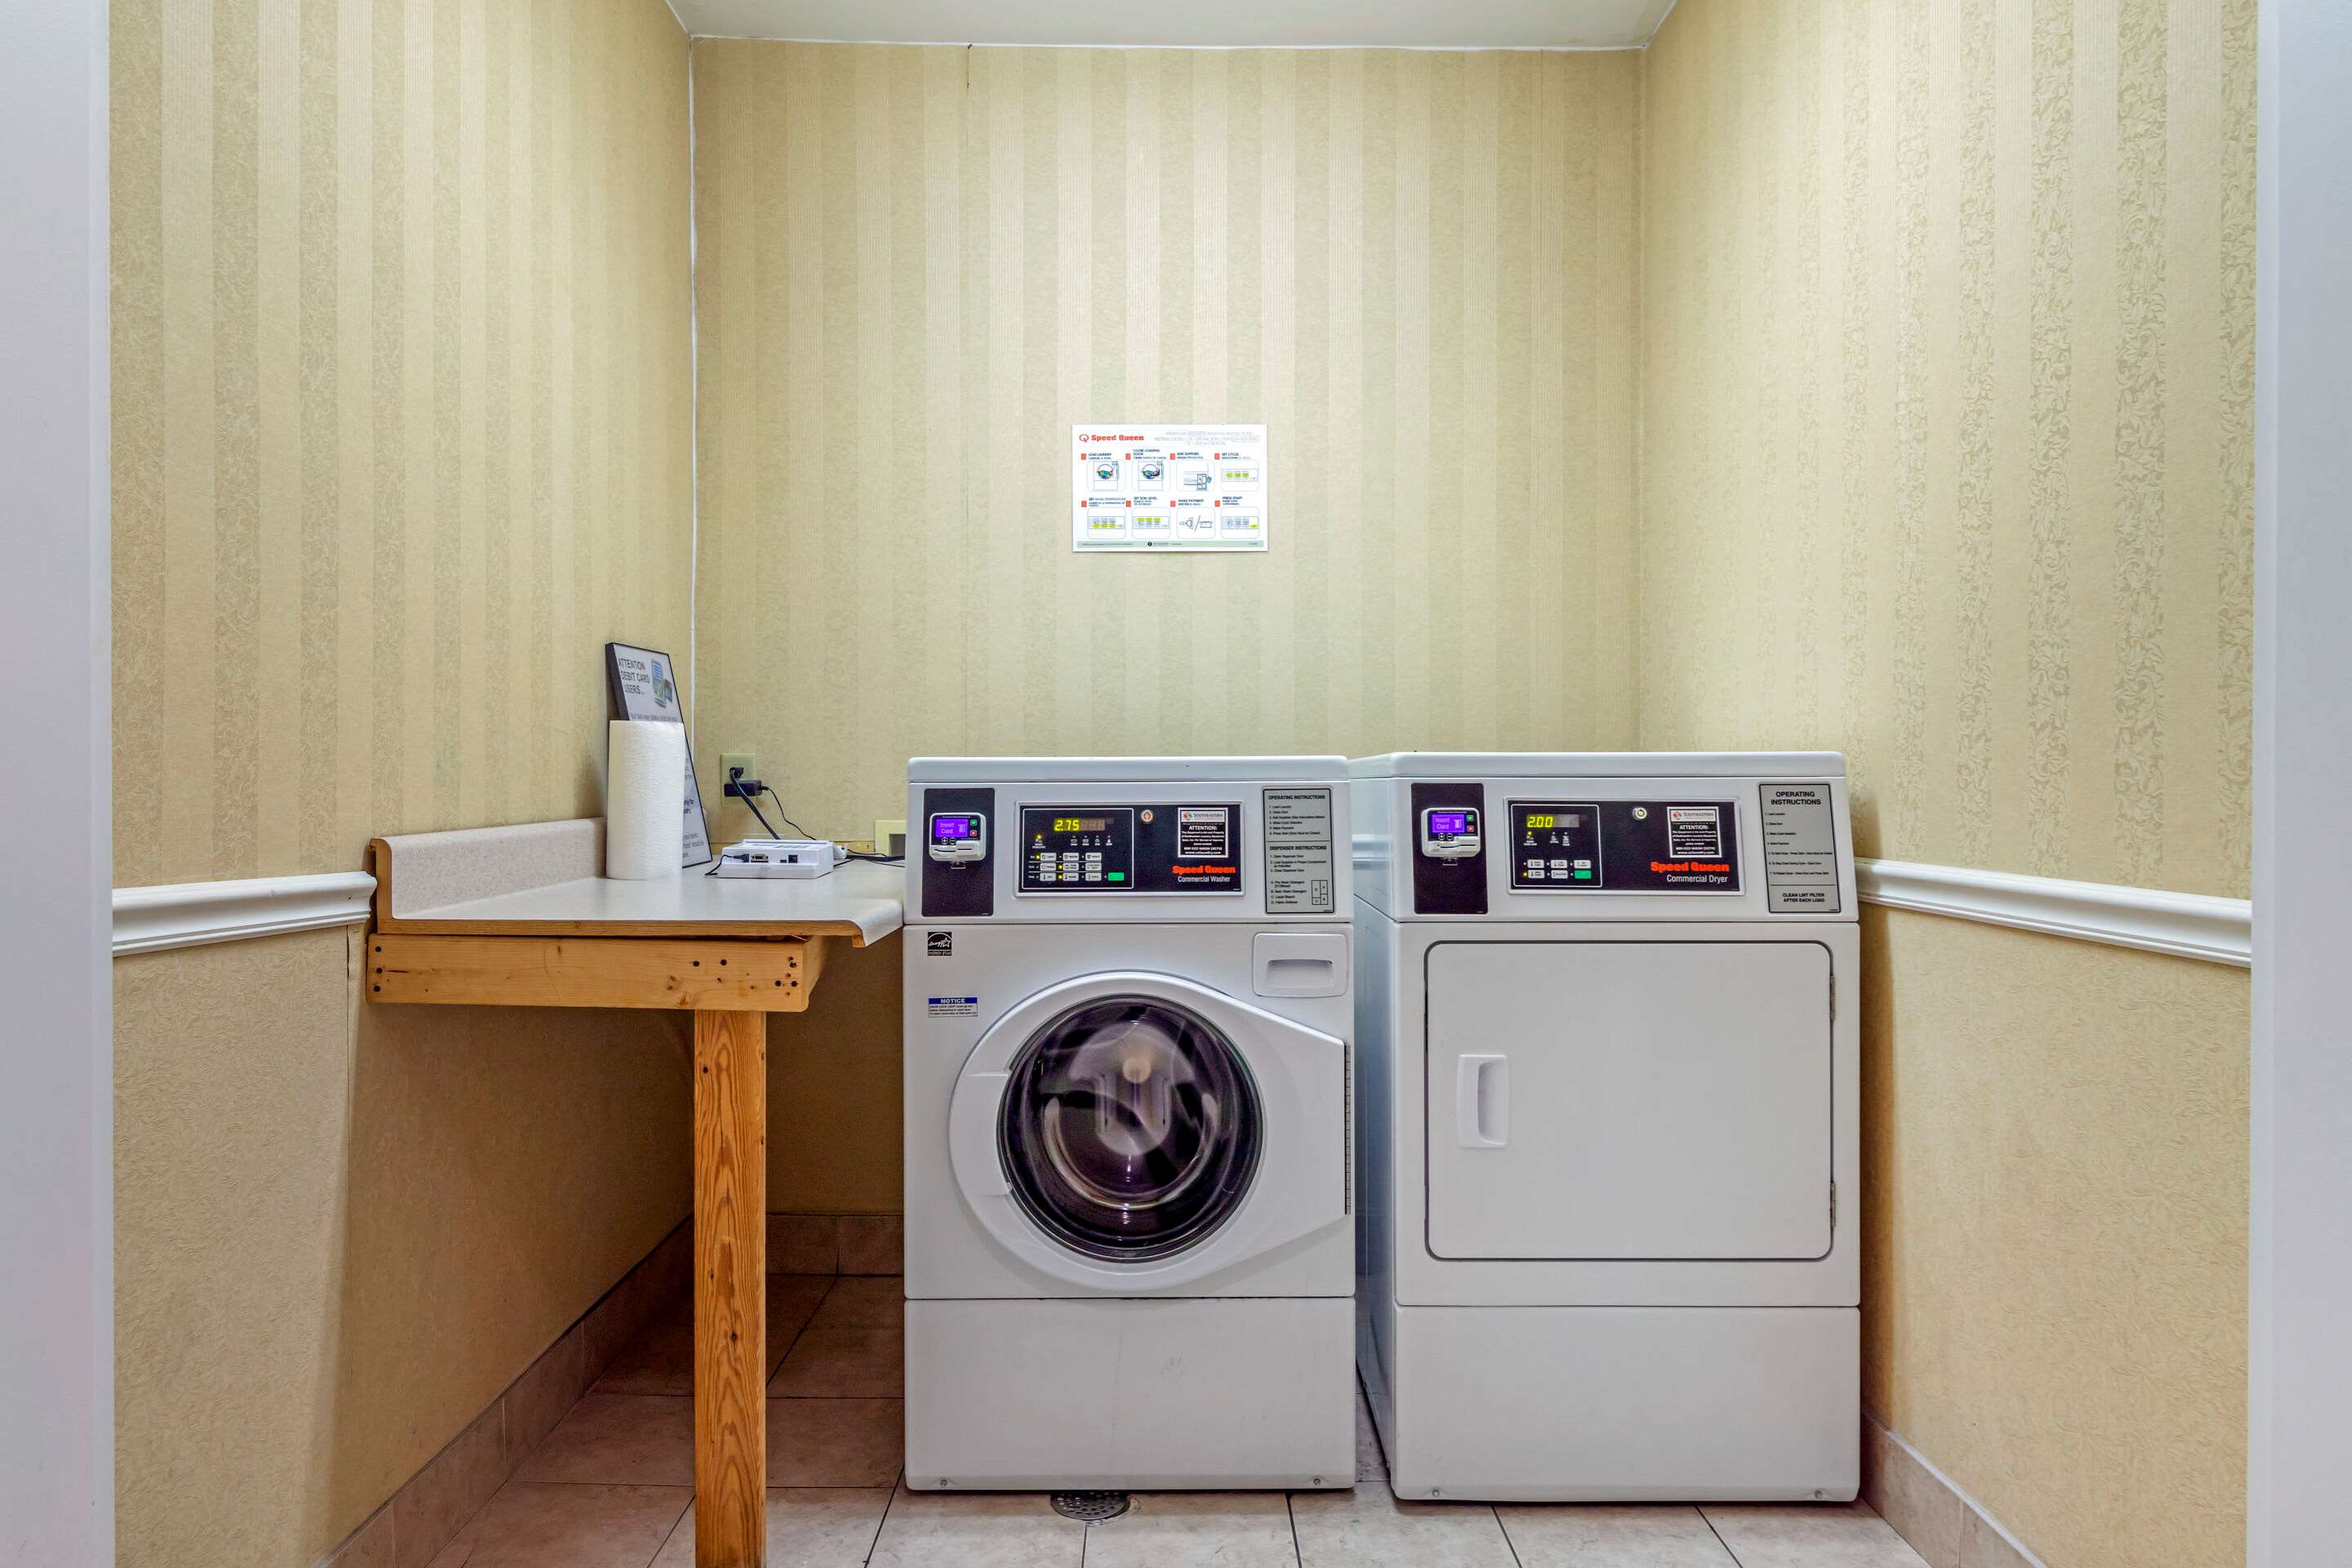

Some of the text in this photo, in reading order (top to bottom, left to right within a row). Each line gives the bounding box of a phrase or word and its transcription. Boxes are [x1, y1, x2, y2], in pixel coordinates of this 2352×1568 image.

[618, 658, 645, 670] ATTENTION
[621, 670, 650, 684] DEBIT CARD
[1054, 819, 1080, 831] 2.75
[1527, 816, 1553, 828] 2.00
[1172, 866, 1203, 875] Speed
[1650, 862, 1730, 873] Speed Queen
[1709, 875, 1728, 884] Dryer
